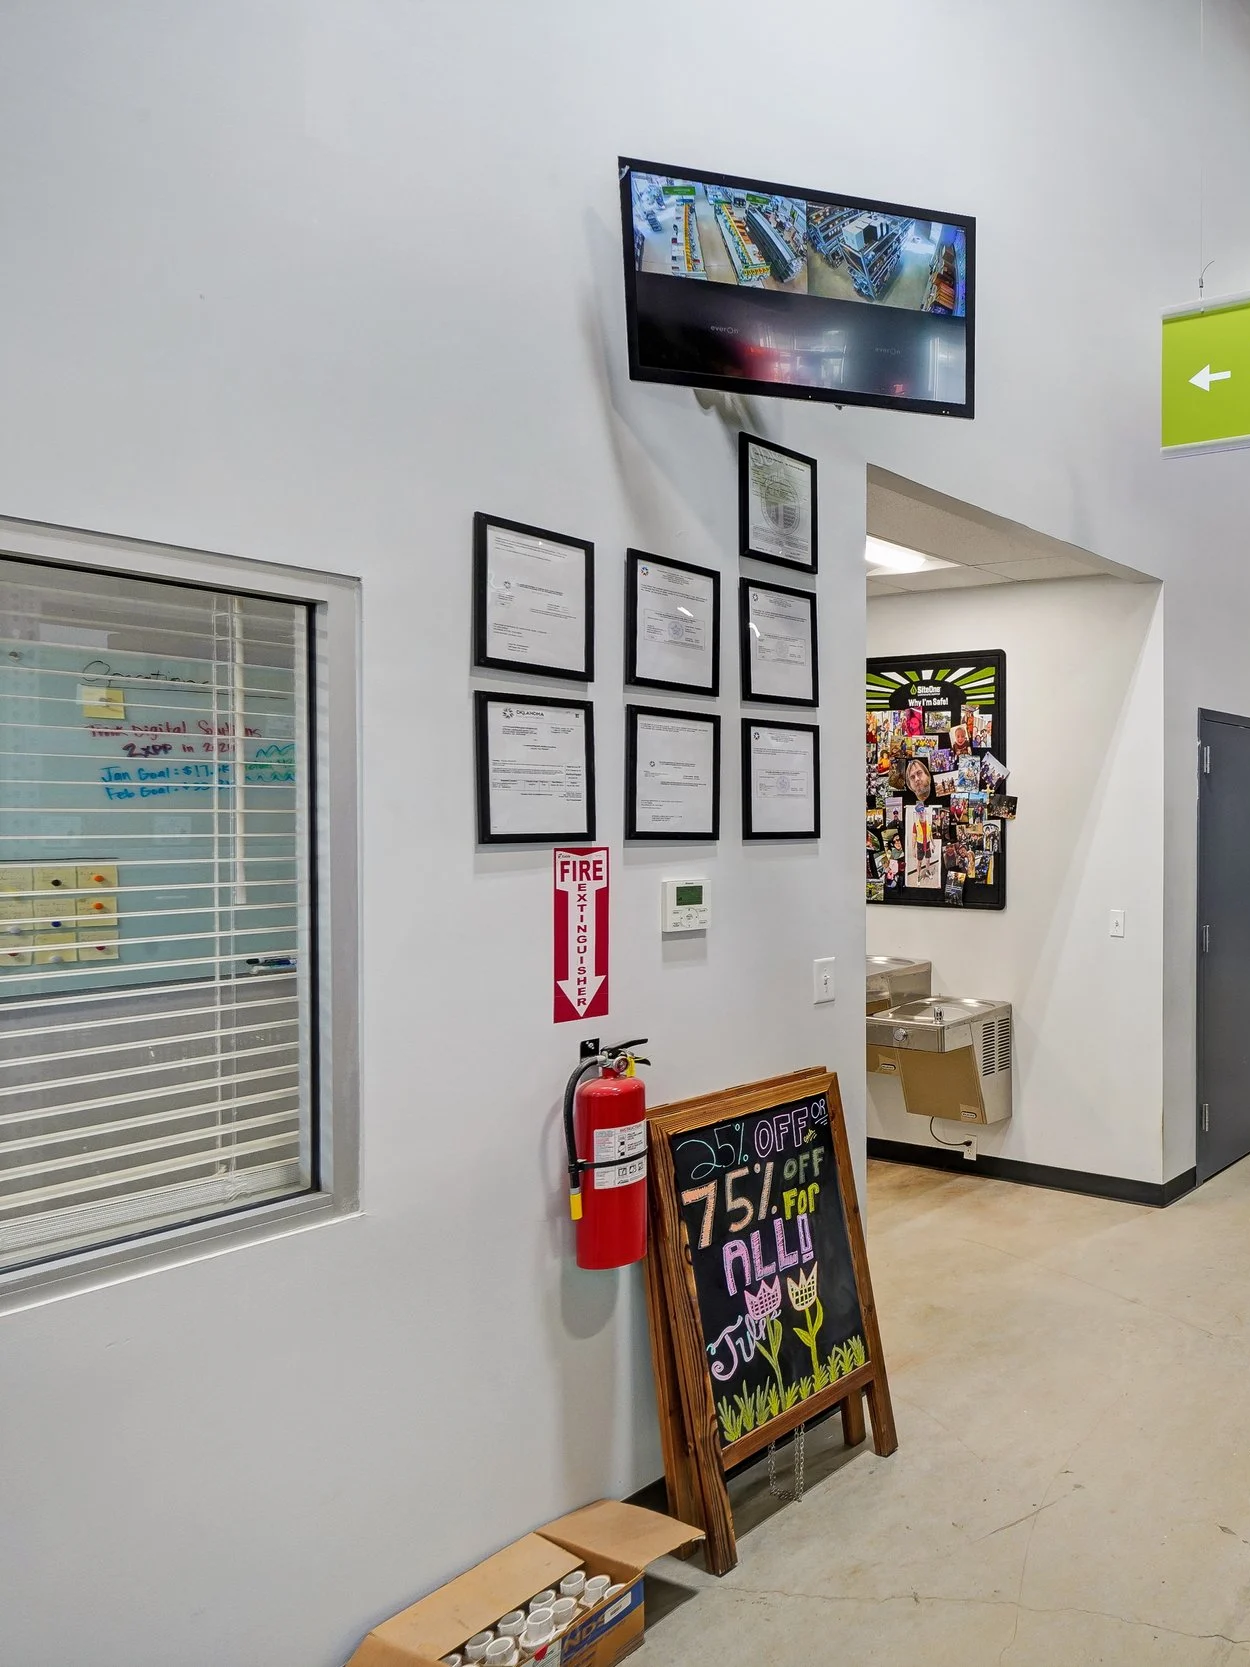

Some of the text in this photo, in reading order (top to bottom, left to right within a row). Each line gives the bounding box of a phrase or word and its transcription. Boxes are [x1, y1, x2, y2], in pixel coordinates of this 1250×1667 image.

[710, 324, 739, 335] everOn
[908, 697, 949, 707] Why I'm Safe!
[917, 686, 942, 694] SiteOne
[560, 860, 604, 883] FIRE
[576, 883, 588, 1007] EXTINGUISHER
[676, 1121, 750, 1180] 25%
[754, 1106, 809, 1158] OFF
[810, 1098, 826, 1119] OR
[681, 1146, 825, 1250] 75% OFF
[722, 1213, 815, 1297] ALL!
